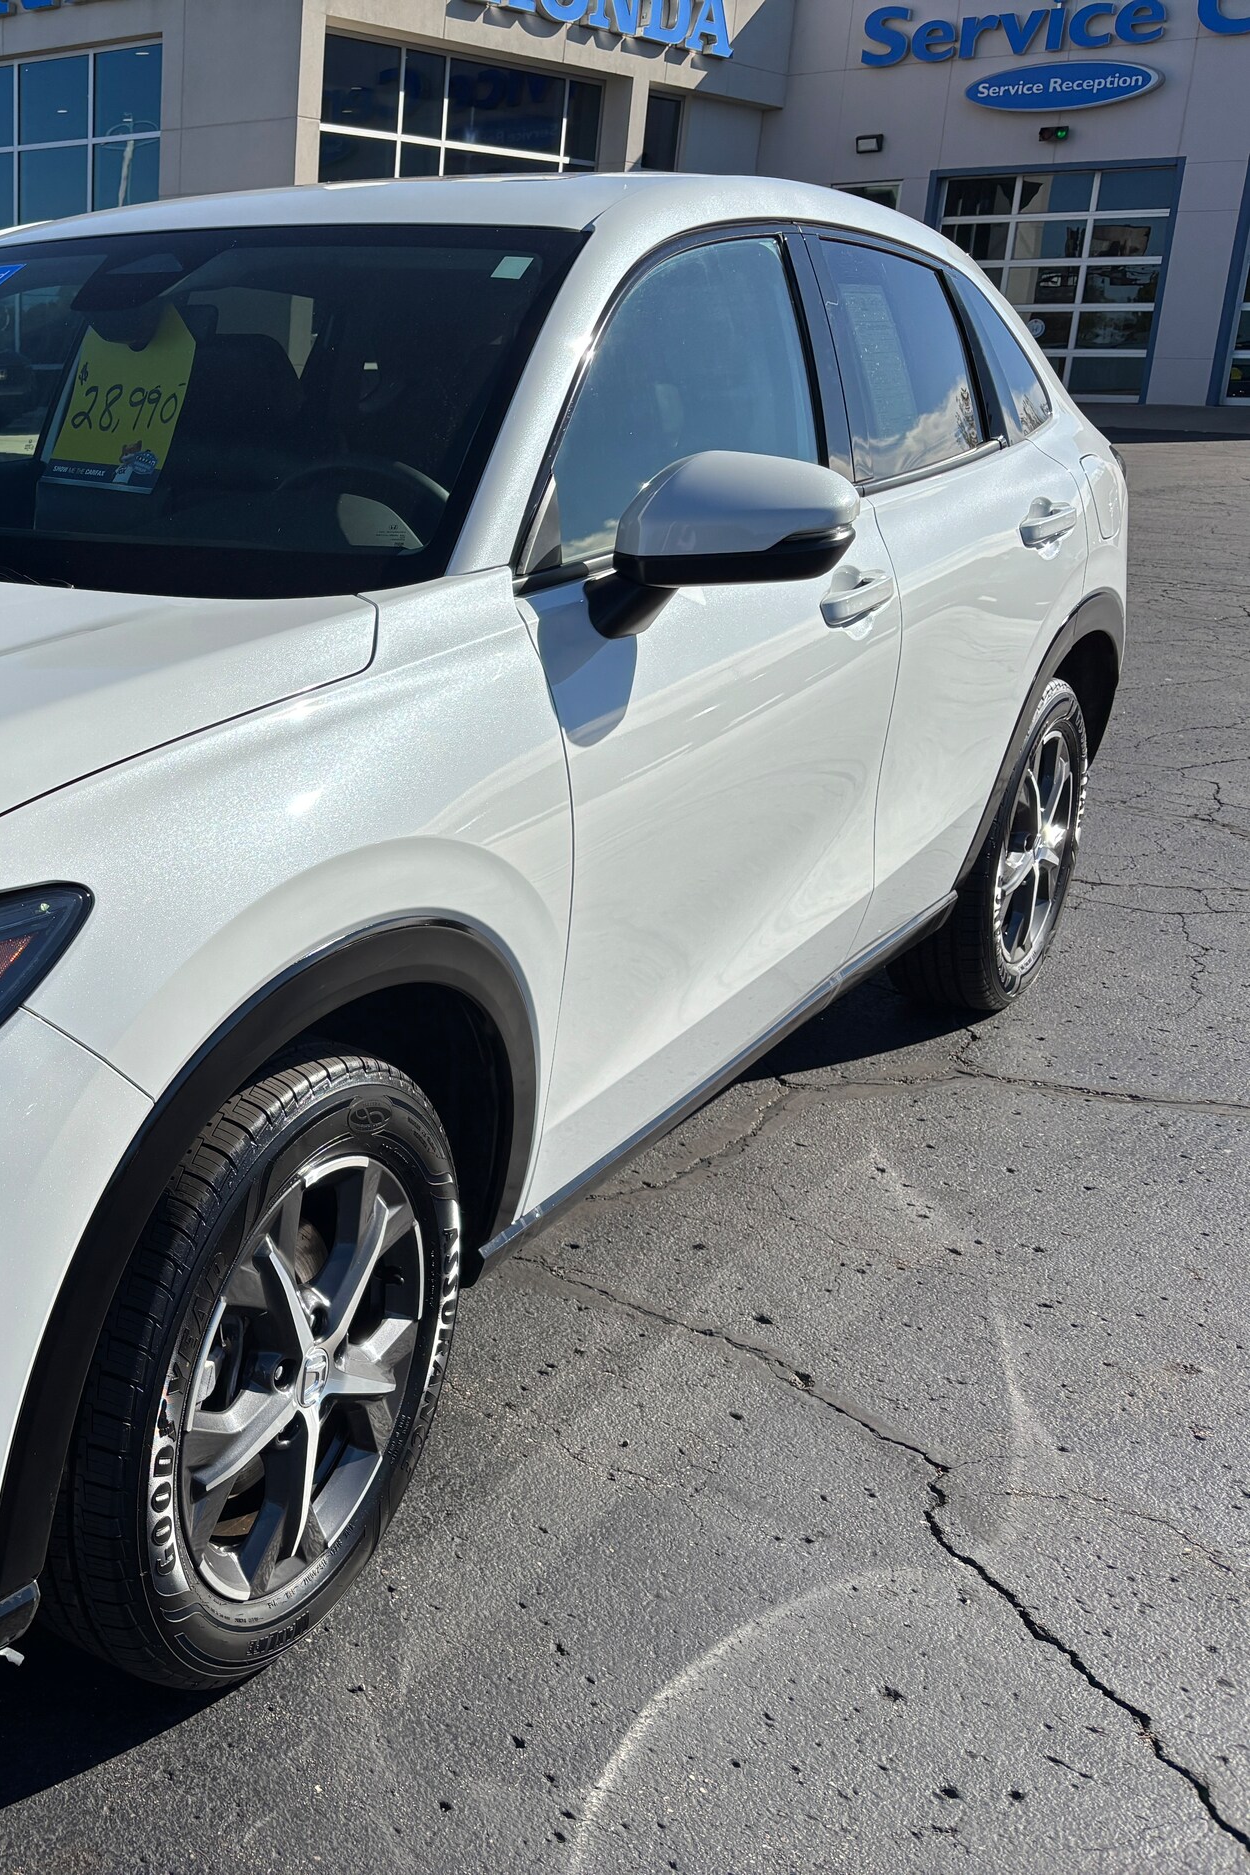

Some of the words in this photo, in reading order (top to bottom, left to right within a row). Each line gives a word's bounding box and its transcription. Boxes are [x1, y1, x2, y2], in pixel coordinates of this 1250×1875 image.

[860, 0, 1167, 67] Service
[977, 80, 1044, 98] Service
[1048, 72, 1144, 94] Reception
[52, 465, 68, 473] SHOW
[85, 468, 107, 477] CARFAX
[401, 1227, 459, 1480] ASSURANCE
